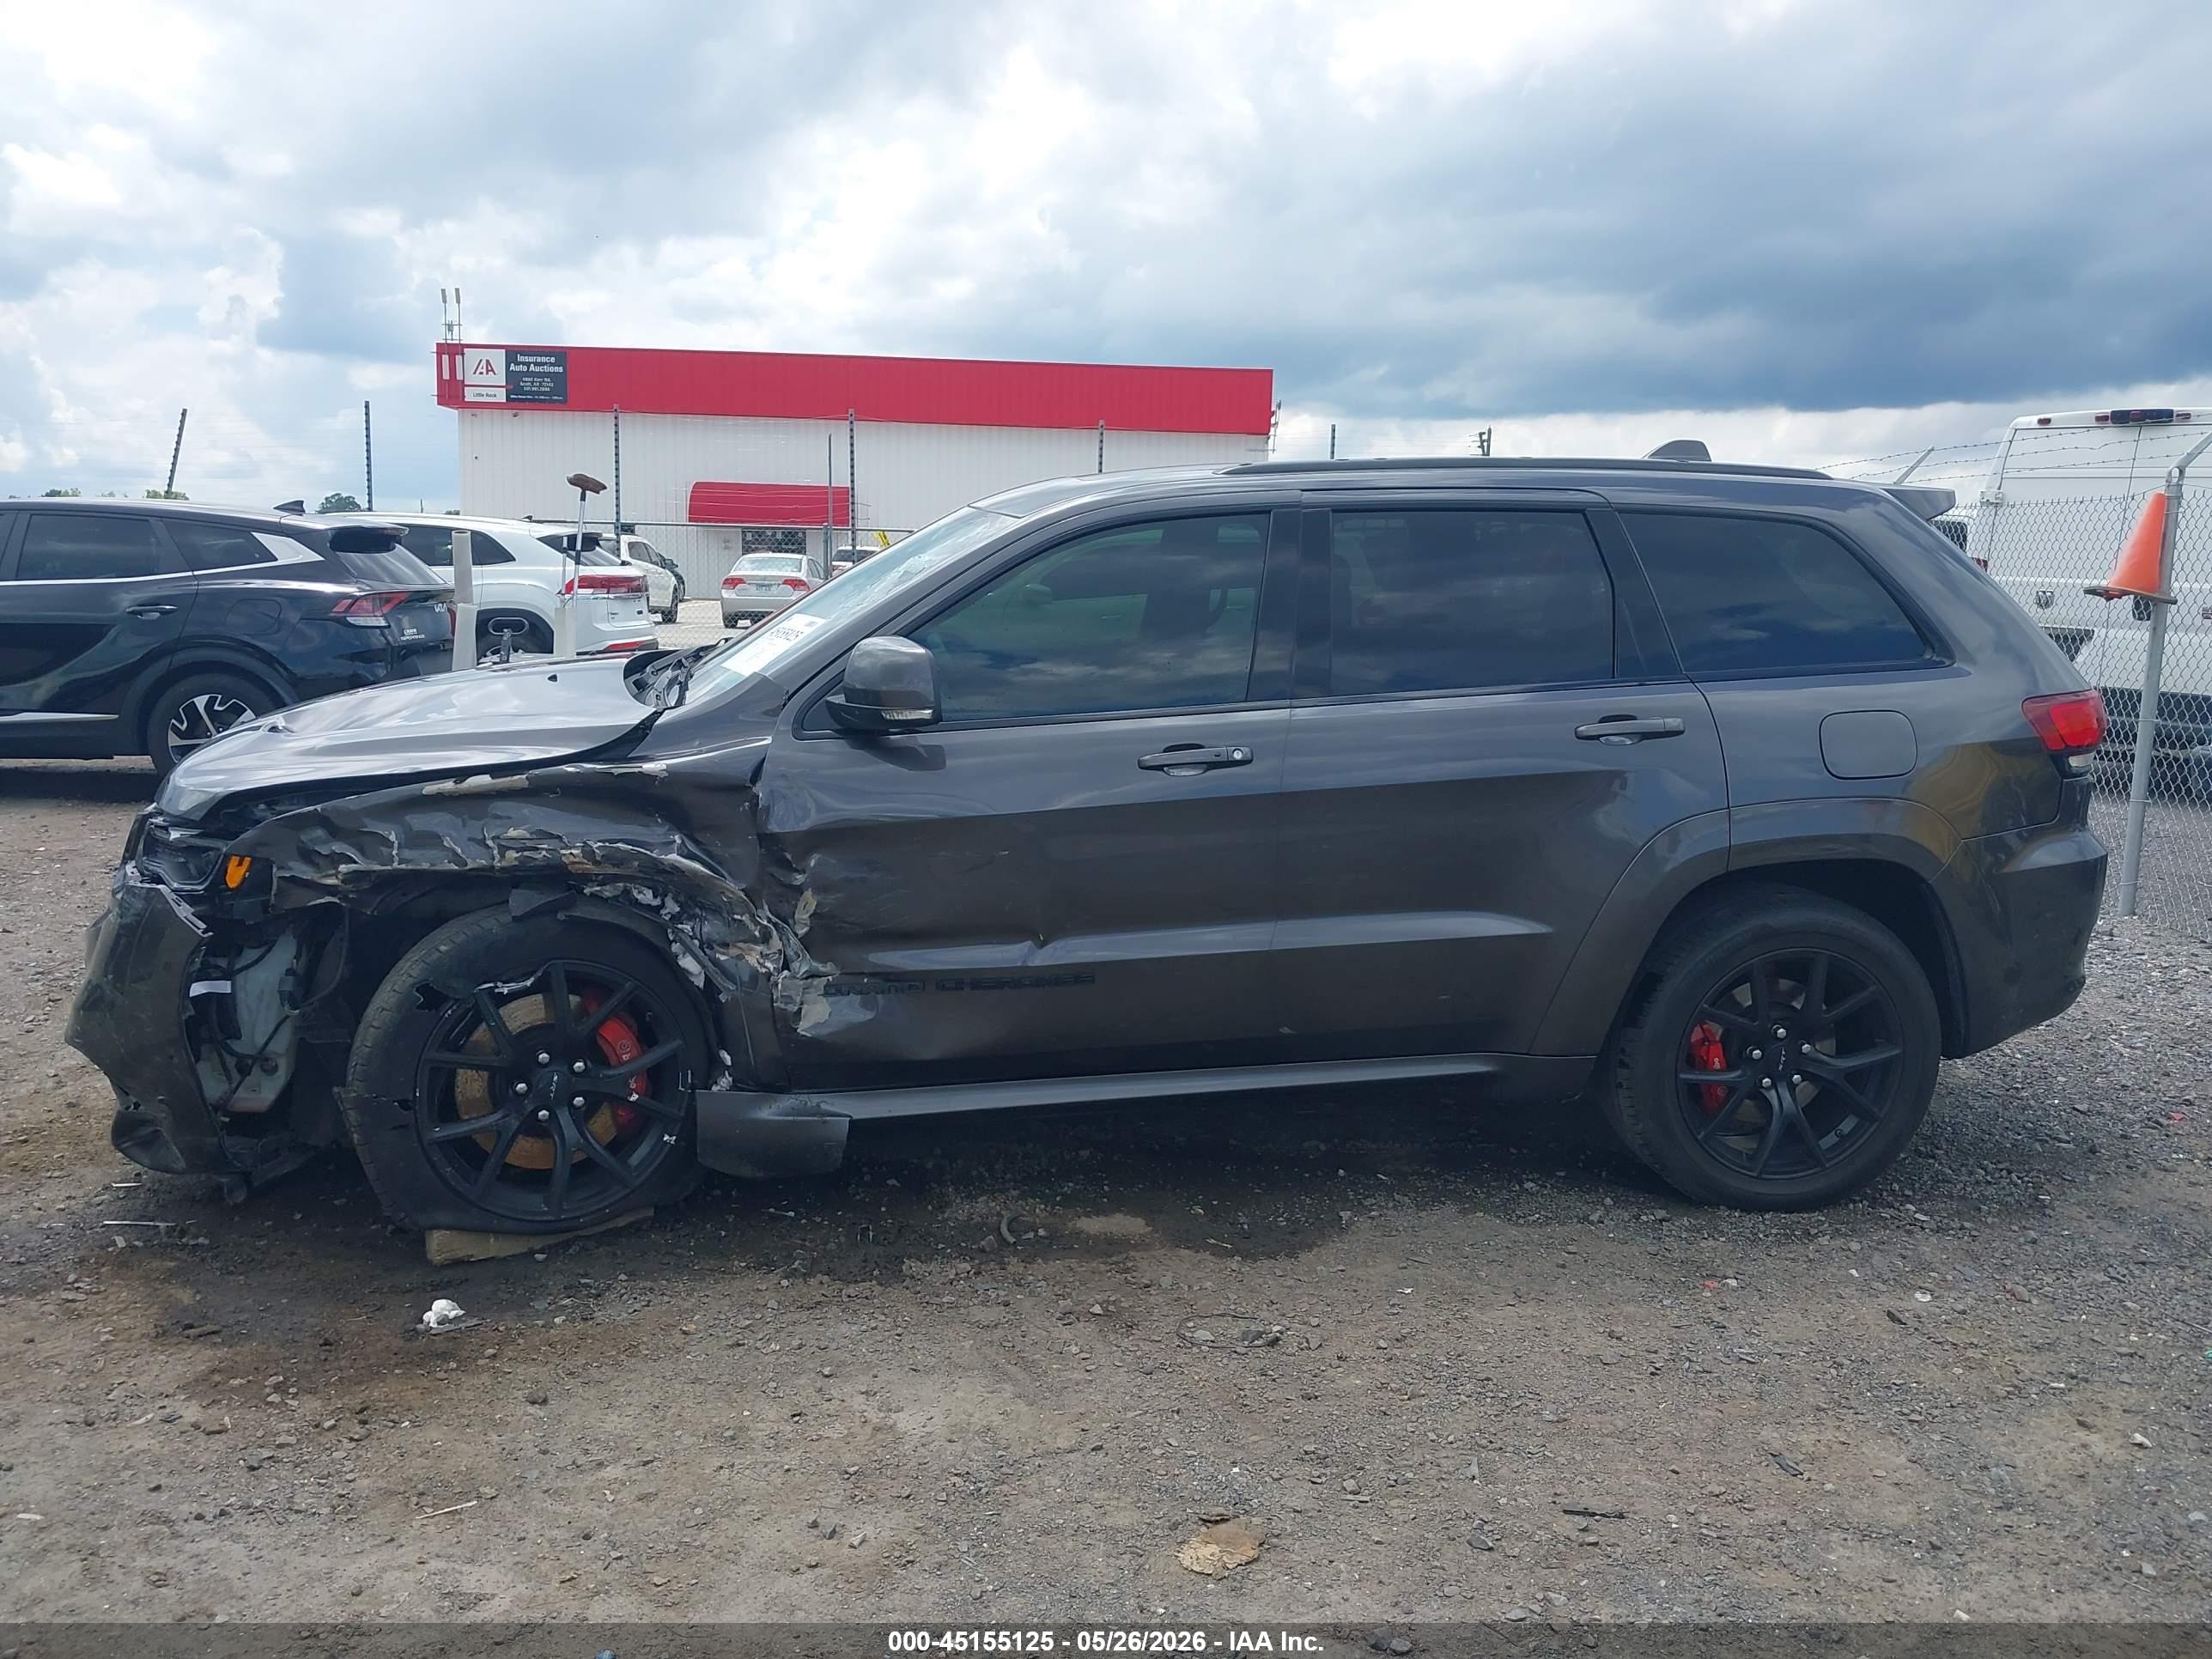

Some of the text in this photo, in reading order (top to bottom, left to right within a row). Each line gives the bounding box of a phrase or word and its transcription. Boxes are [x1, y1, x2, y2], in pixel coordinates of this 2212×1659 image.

[517, 353, 556, 362] Insurance
[509, 362, 563, 373] Auto Auctions
